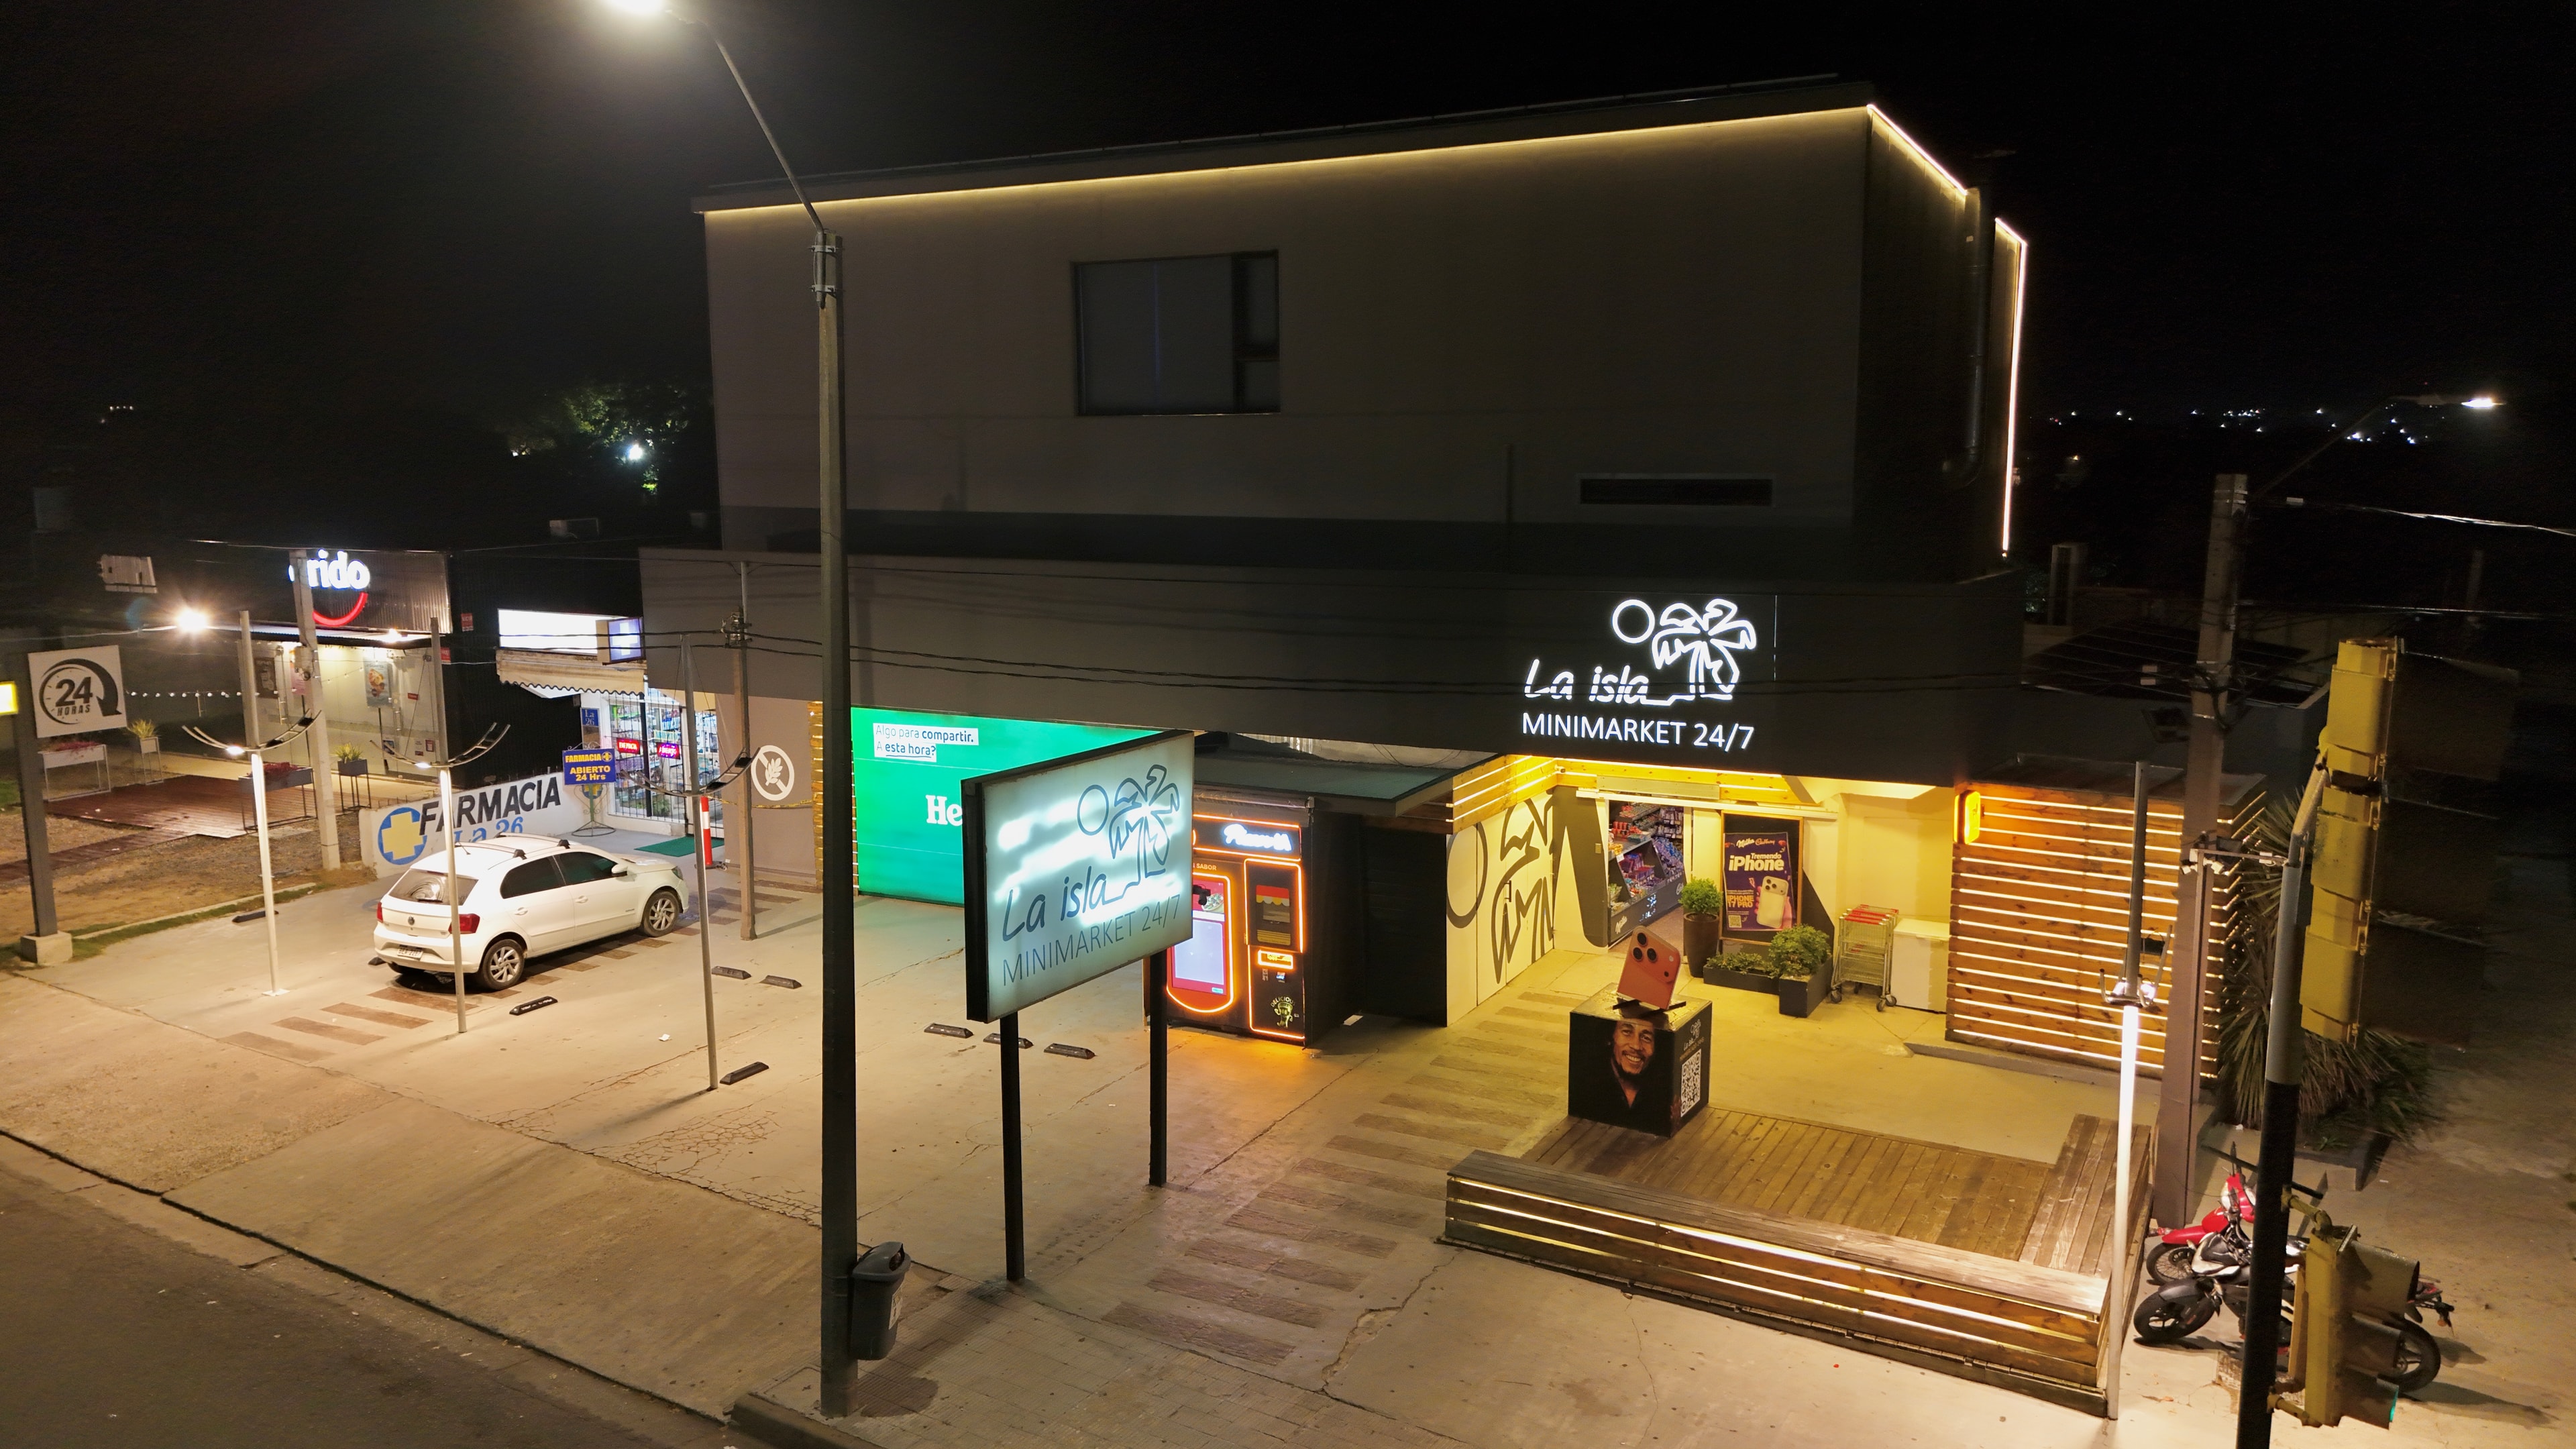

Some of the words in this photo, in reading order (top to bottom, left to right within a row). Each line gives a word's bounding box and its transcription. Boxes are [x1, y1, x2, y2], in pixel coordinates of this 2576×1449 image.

[288, 549, 370, 590] rido
[1524, 659, 1574, 700] La
[1589, 665, 1650, 704] isla
[55, 676, 93, 707] 24
[57, 704, 91, 716] HORAS
[585, 709, 595, 718] La
[585, 717, 595, 725] 26
[875, 725, 896, 739] Algo
[899, 729, 920, 739] para
[922, 731, 974, 743] compartir.
[1523, 712, 1686, 745] MINIMARKET
[1693, 722, 1754, 752] 24/7
[877, 741, 883, 751] A
[885, 743, 906, 753] esta
[908, 743, 936, 755] hora?
[565, 753, 602, 763] FARMACIA
[570, 765, 611, 775] ABIERTO
[925, 794, 963, 826] He
[1196, 863, 1217, 871] SABOR
[1729, 855, 1784, 871] iPhone
[1003, 889, 1046, 942] La
[1061, 865, 1107, 921] isla
[1003, 911, 1136, 986] MINIMARKET
[1142, 894, 1181, 932] 24/7
